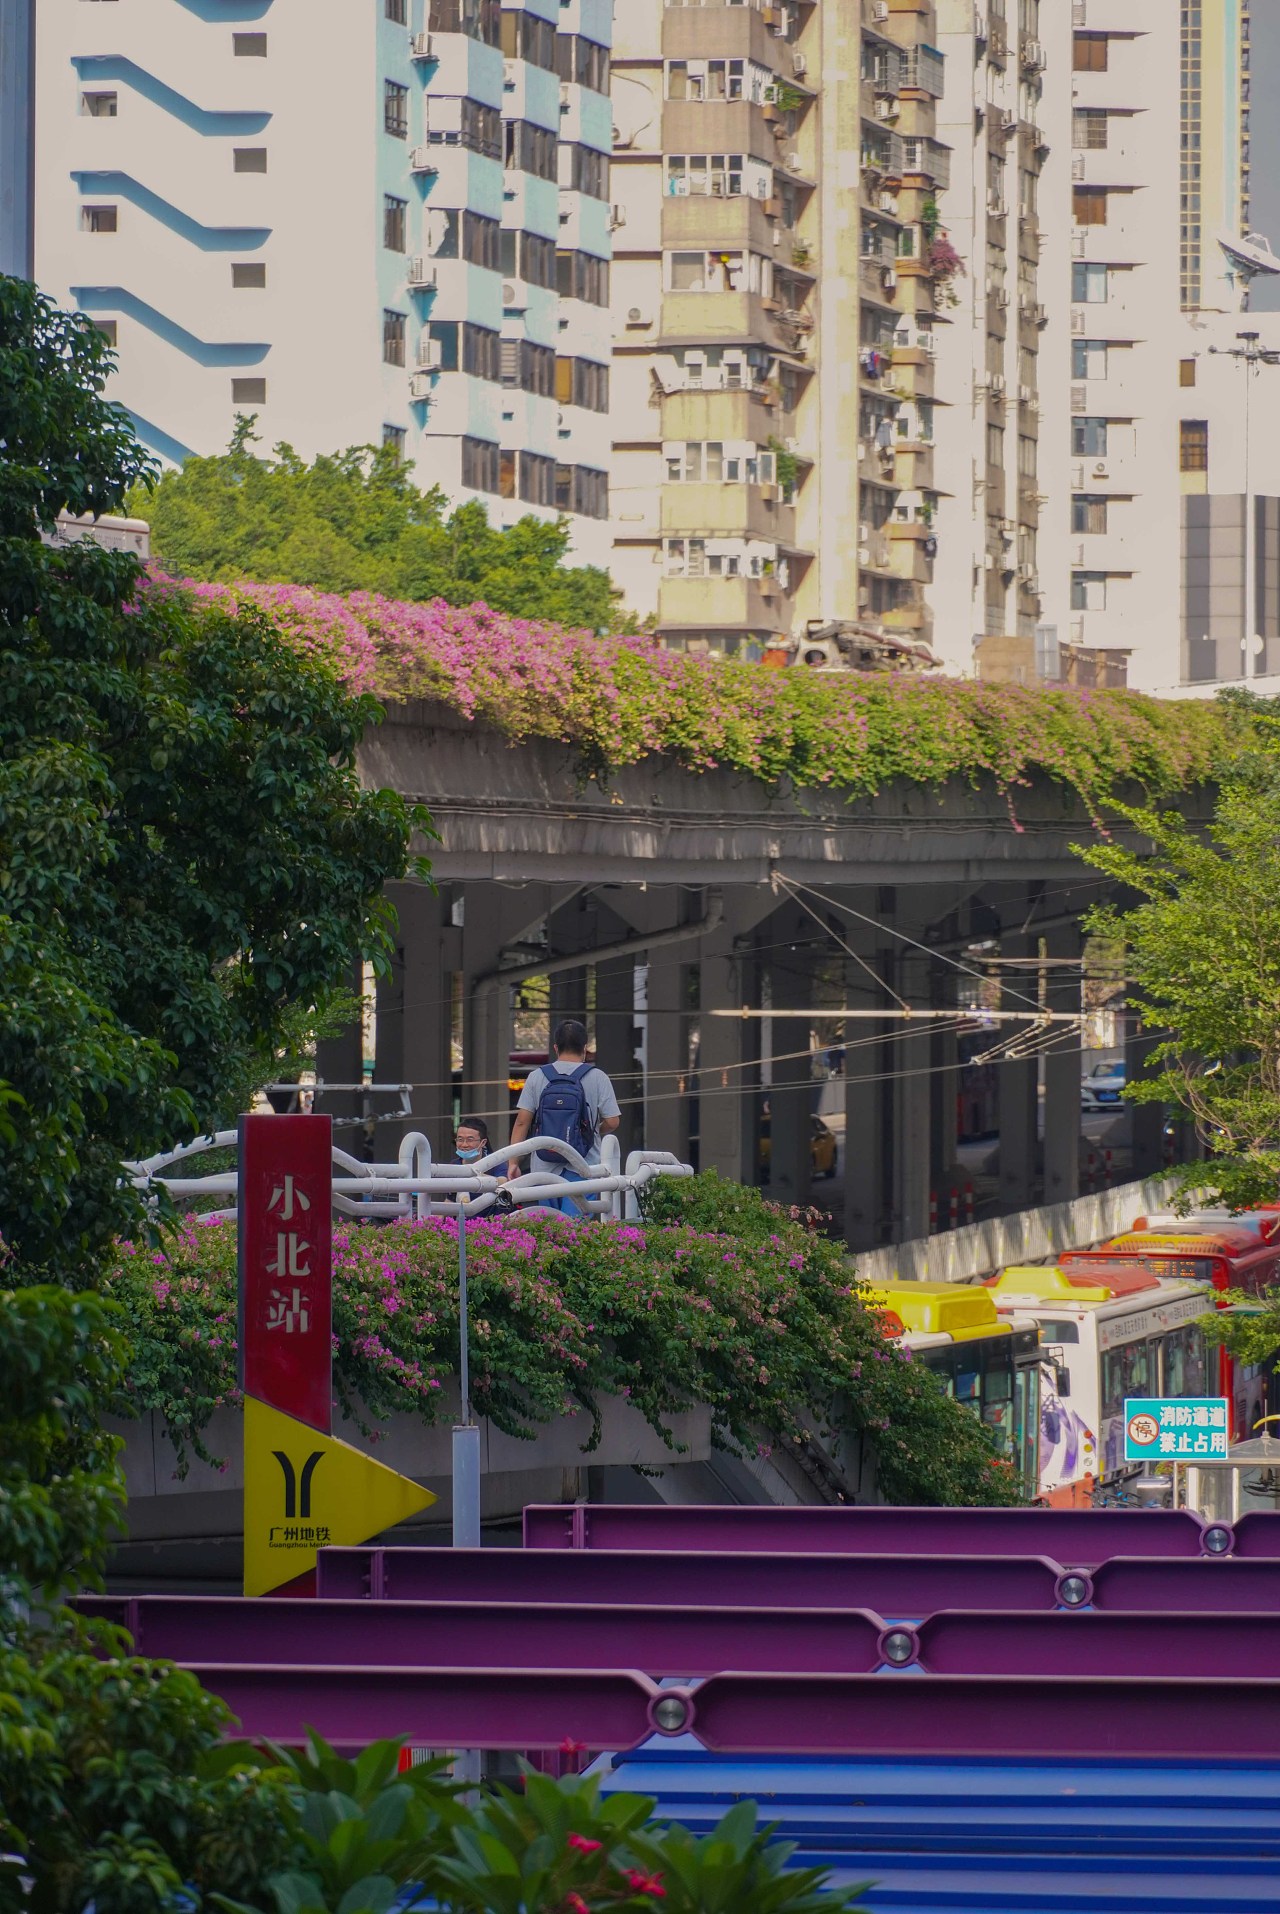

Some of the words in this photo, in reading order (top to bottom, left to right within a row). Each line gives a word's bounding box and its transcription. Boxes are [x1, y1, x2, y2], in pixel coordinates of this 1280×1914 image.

[265, 1174, 311, 1333] 小北站
[1160, 1406, 1226, 1427] 消防通道
[1159, 1432, 1226, 1453] 禁止占用
[269, 1526, 331, 1541] 广州地铁
[269, 1541, 308, 1549] Guangzhou
